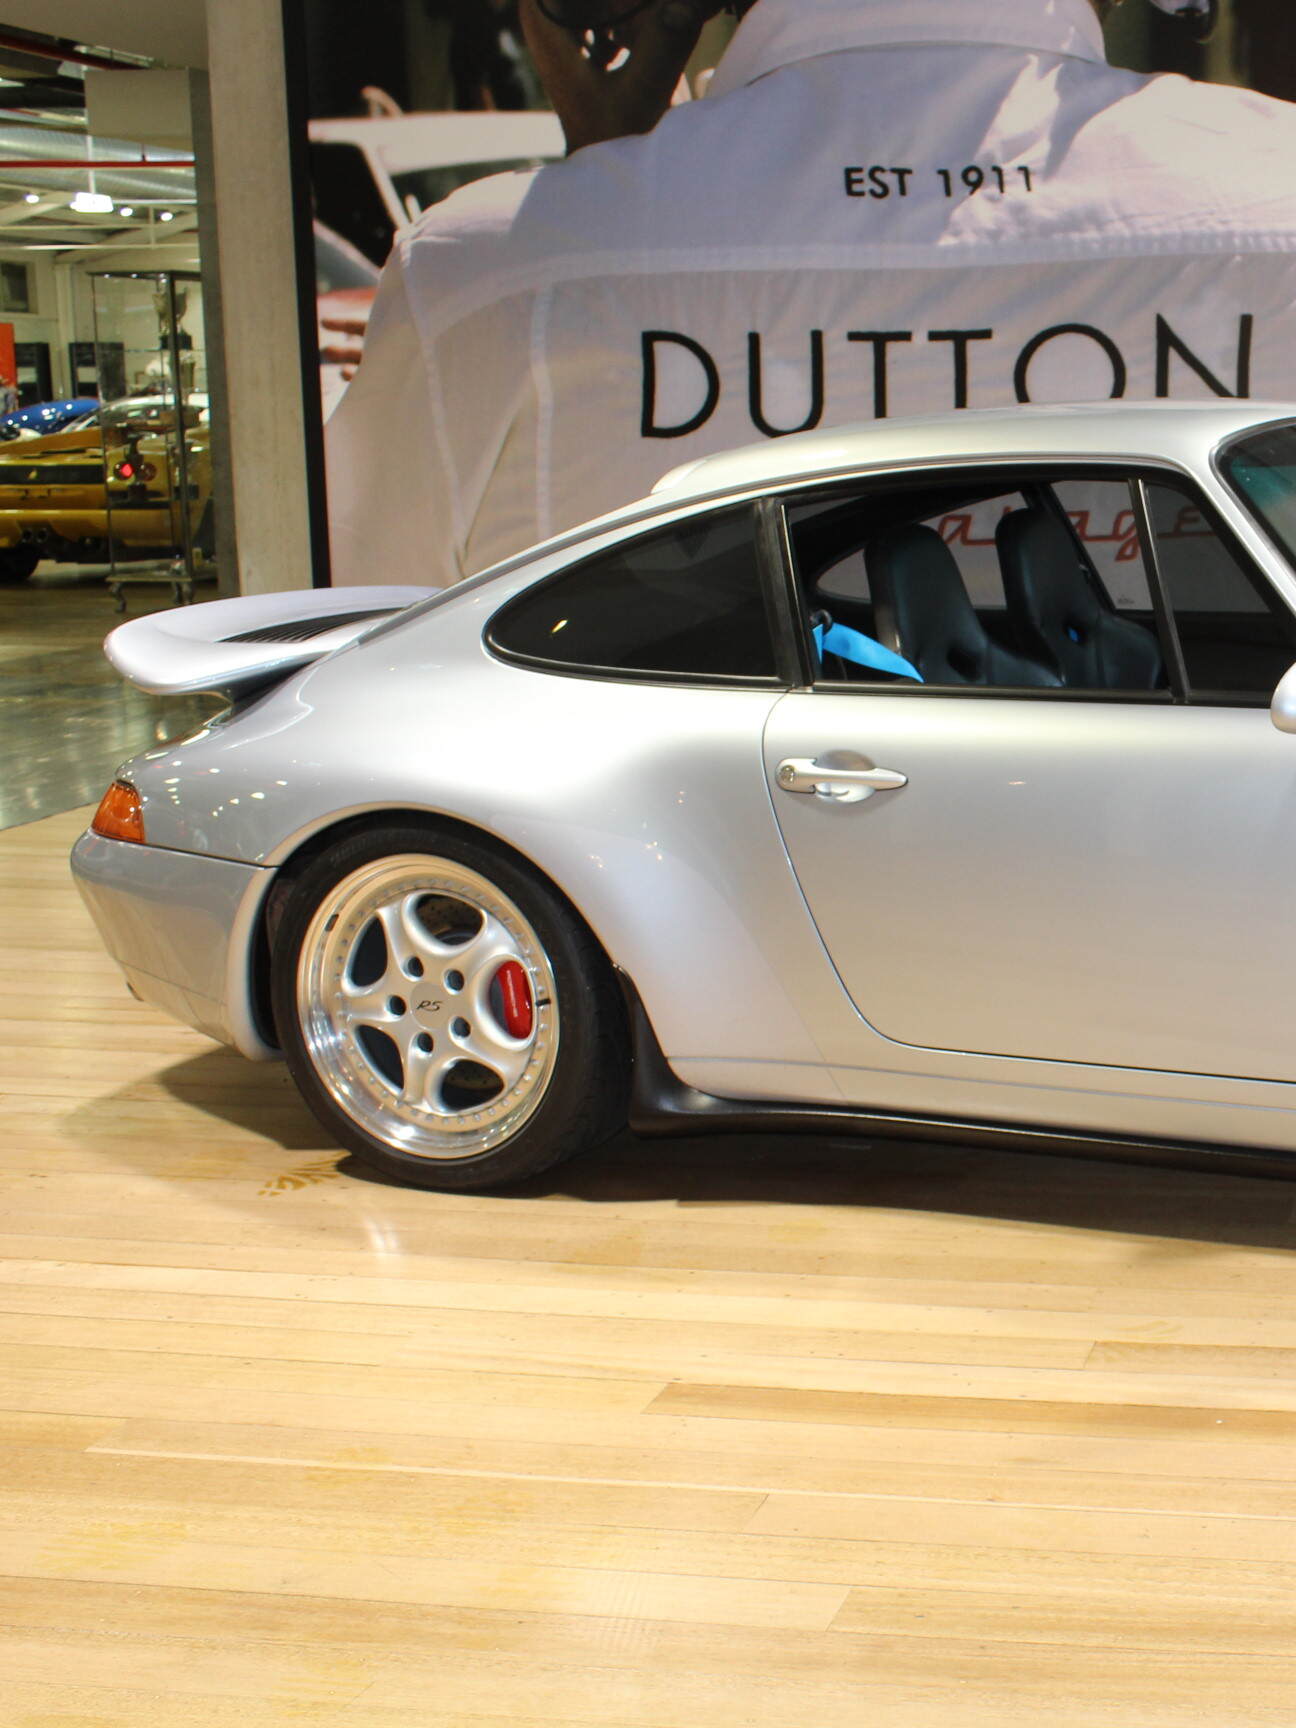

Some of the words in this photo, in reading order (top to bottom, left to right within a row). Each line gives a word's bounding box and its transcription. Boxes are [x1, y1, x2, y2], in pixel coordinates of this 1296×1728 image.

[843, 166, 913, 199] EST
[937, 165, 1033, 198] 1911
[641, 312, 1253, 438] DUTTON
